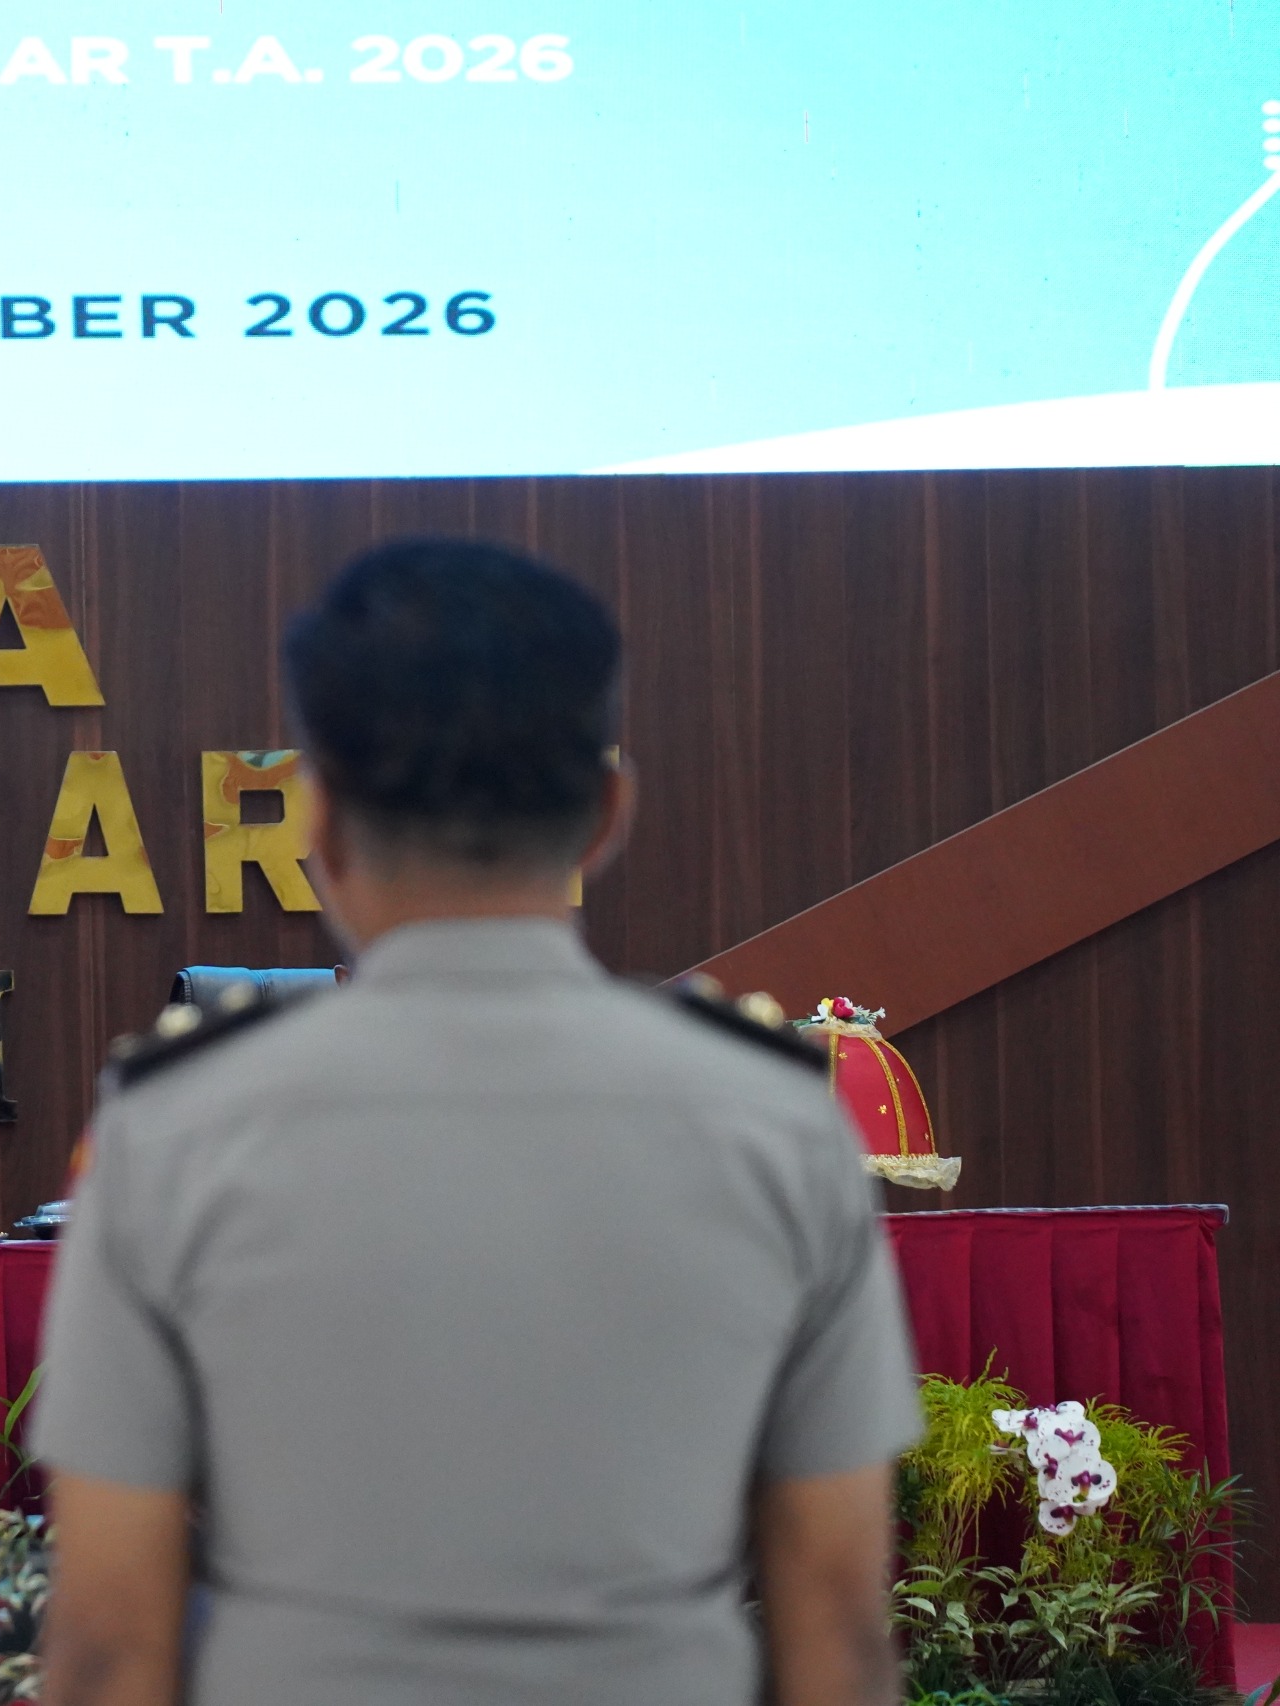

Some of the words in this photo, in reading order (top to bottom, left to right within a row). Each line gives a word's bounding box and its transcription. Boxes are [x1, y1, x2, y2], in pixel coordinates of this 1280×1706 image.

[154, 36, 323, 84] T.A.
[350, 35, 573, 83] 2026
[245, 292, 496, 337] 2026
